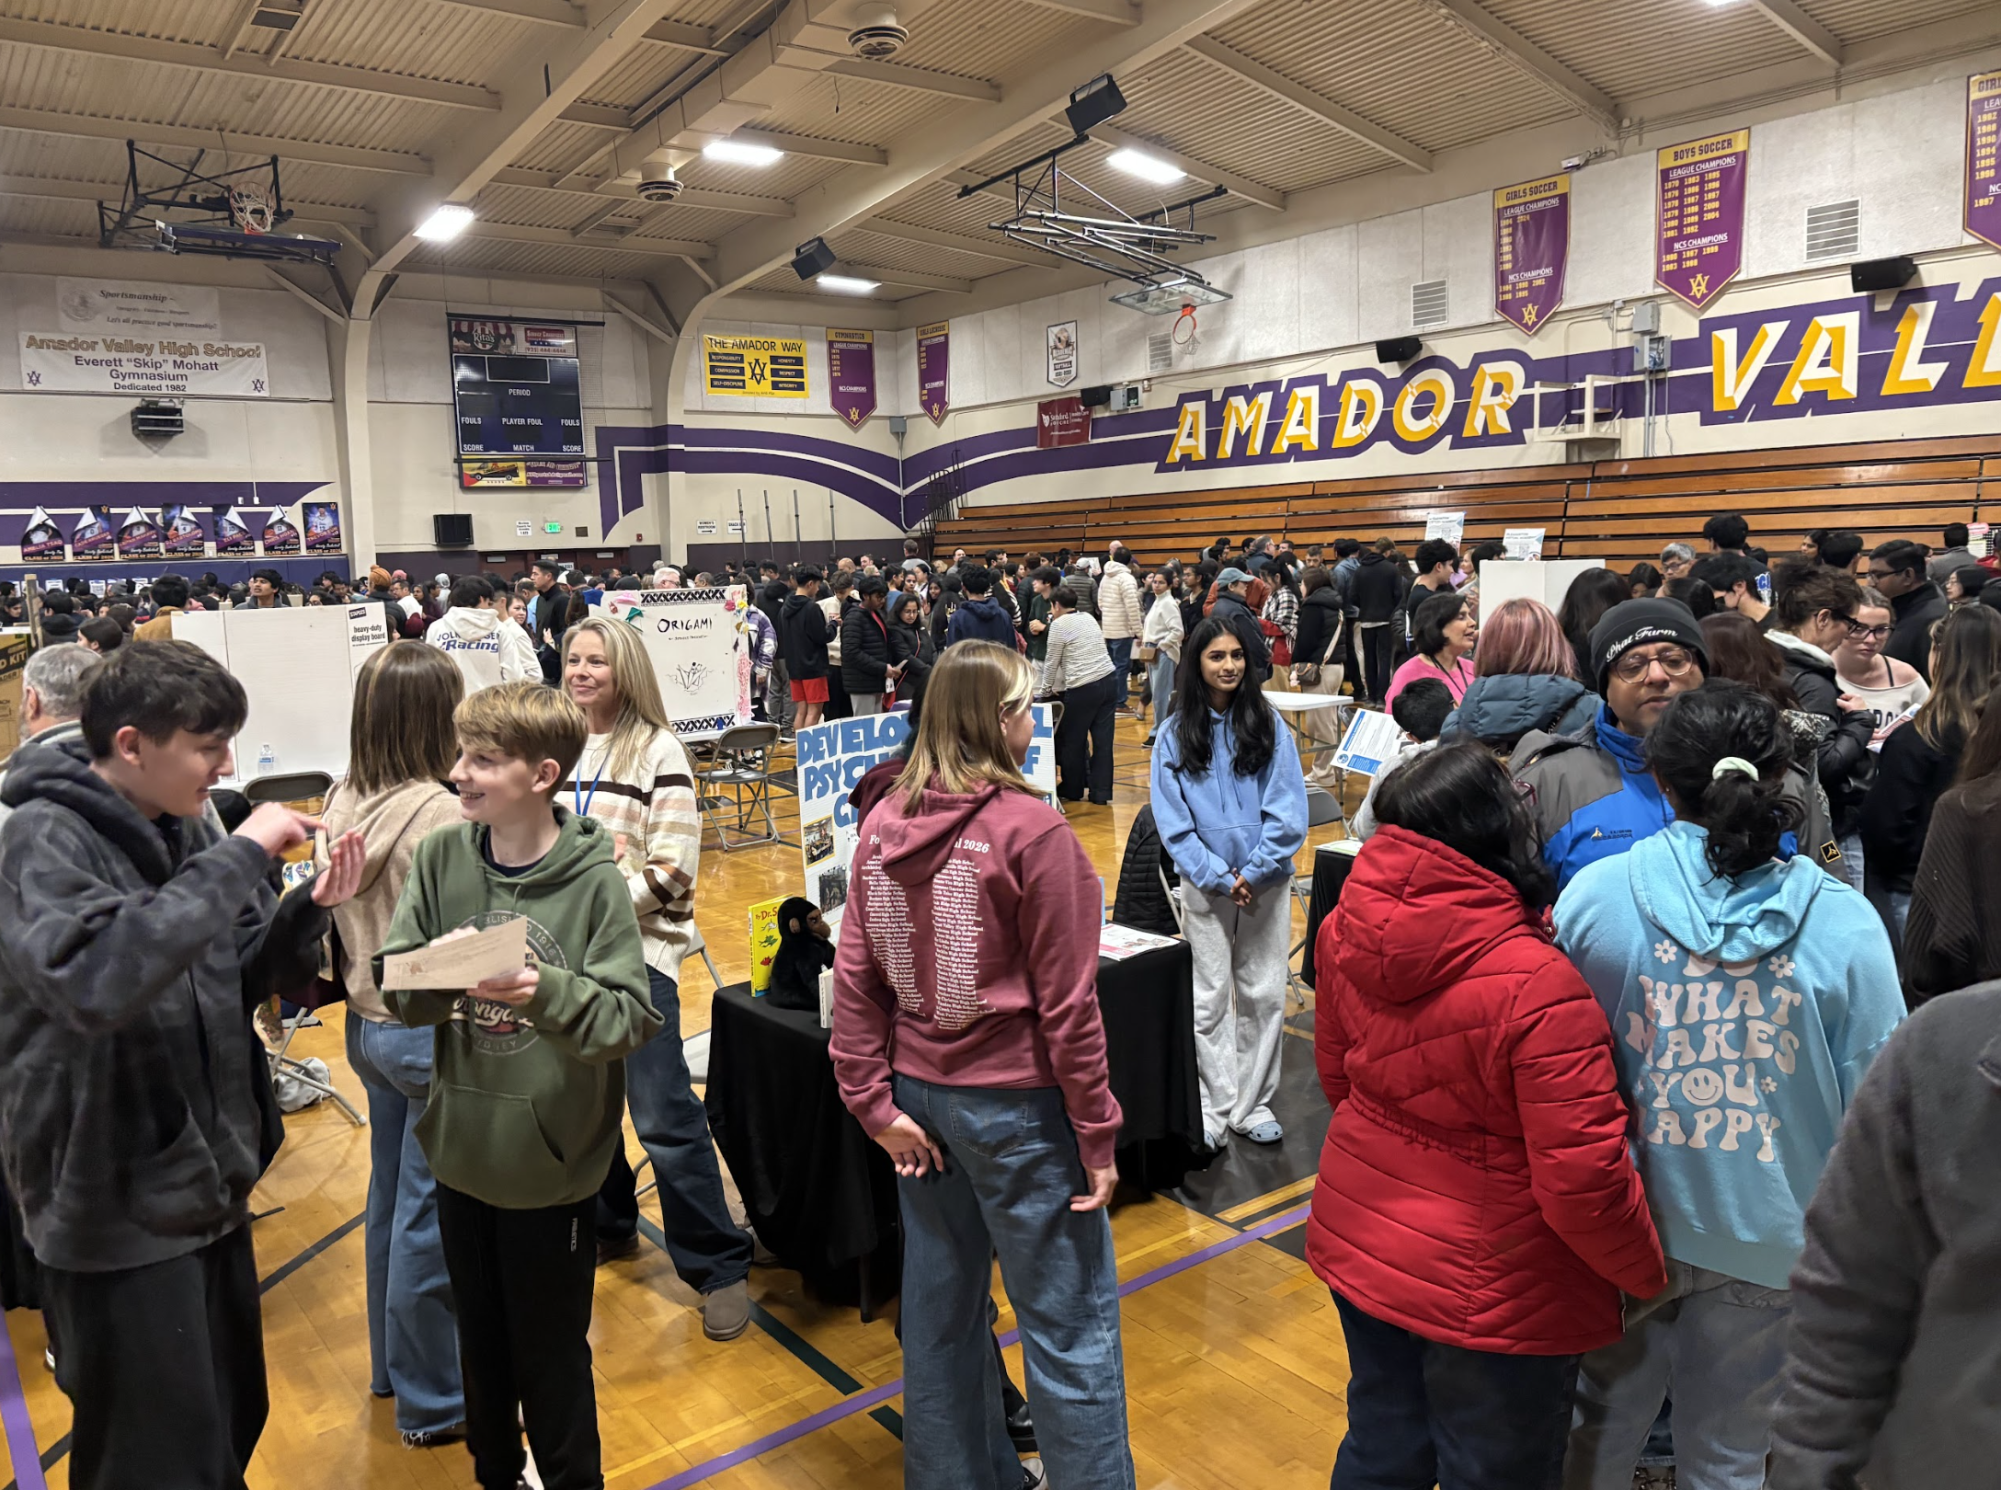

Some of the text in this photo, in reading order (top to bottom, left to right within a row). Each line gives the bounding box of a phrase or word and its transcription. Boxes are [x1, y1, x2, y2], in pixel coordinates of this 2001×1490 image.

[1673, 138, 1733, 161] BOYS SOCCER
[1669, 156, 1736, 178] LEAGUE CHAMPIONS
[1506, 181, 1558, 202] GIRLS SOCCER
[1503, 197, 1559, 216] LEAGUE CHAMPIONS
[1974, 197, 1994, 208] 1997
[1673, 233, 1728, 250] NCS CHAMPIONS
[1508, 267, 1553, 282] NCS CHAMPIONS
[100, 289, 168, 304] Sportsmanship
[473, 333, 495, 343] Rita's
[708, 337, 802, 353] THE AMADOR WAY
[25, 335, 261, 358] Amador Valley High School
[74, 355, 123, 368] Everett
[173, 360, 219, 371] Mohatt
[109, 368, 188, 382] Gymnasium
[113, 382, 187, 393] Dedicated 1982
[508, 388, 531, 396] PERIOD
[1166, 361, 1526, 463] AMADOR
[461, 417, 482, 425] FOULS
[527, 418, 543, 426] FOUL
[463, 444, 484, 452] SCORE
[513, 444, 535, 452] MATCH
[354, 624, 382, 634] heavy-duty
[657, 617, 712, 632] ORIGAMI
[351, 631, 386, 643] display board
[446, 640, 499, 653] Racing
[10, 651, 27, 666] KIT
[963, 839, 990, 854] 2026
[1638, 975, 1802, 1027] WHAT
[1625, 1011, 1800, 1075] MAKES
